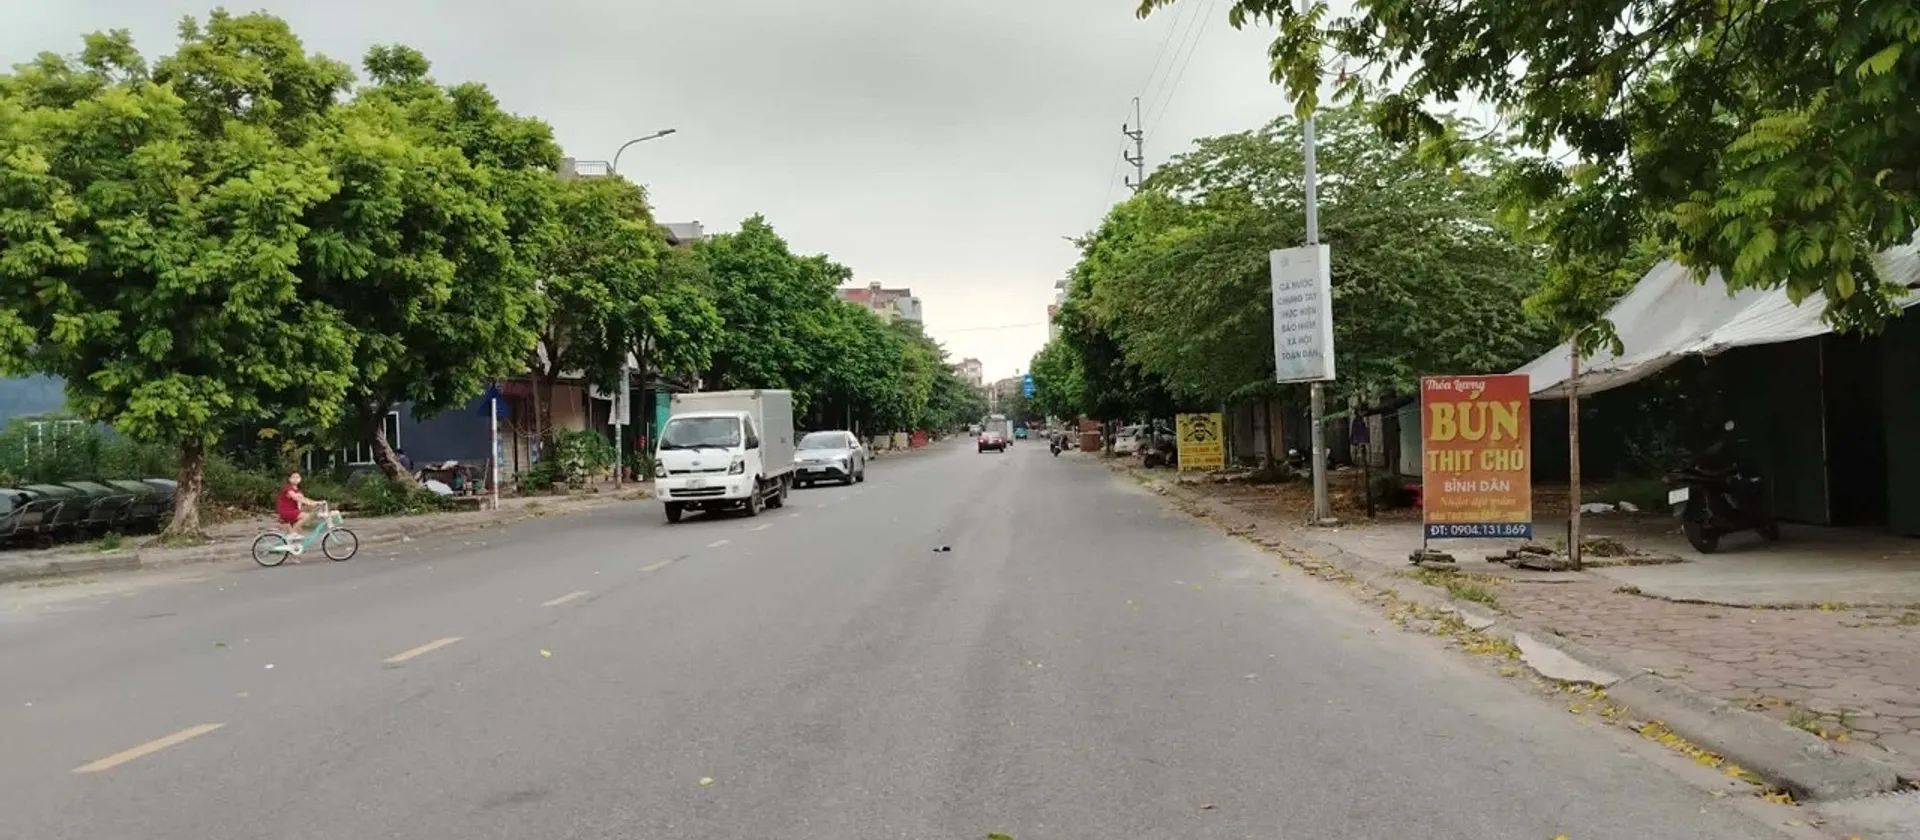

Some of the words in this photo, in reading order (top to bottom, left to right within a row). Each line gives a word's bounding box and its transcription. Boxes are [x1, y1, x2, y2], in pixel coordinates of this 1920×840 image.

[1430, 390, 1521, 441] BÚN
[1427, 450, 1474, 476] THỊT
[1481, 444, 1524, 472] CHÓ
[1444, 478, 1476, 492] BÌNH
[1480, 478, 1510, 492] DÂN
[1430, 525, 1448, 536] ĐT:
[1450, 524, 1527, 536] 0904.131.869
